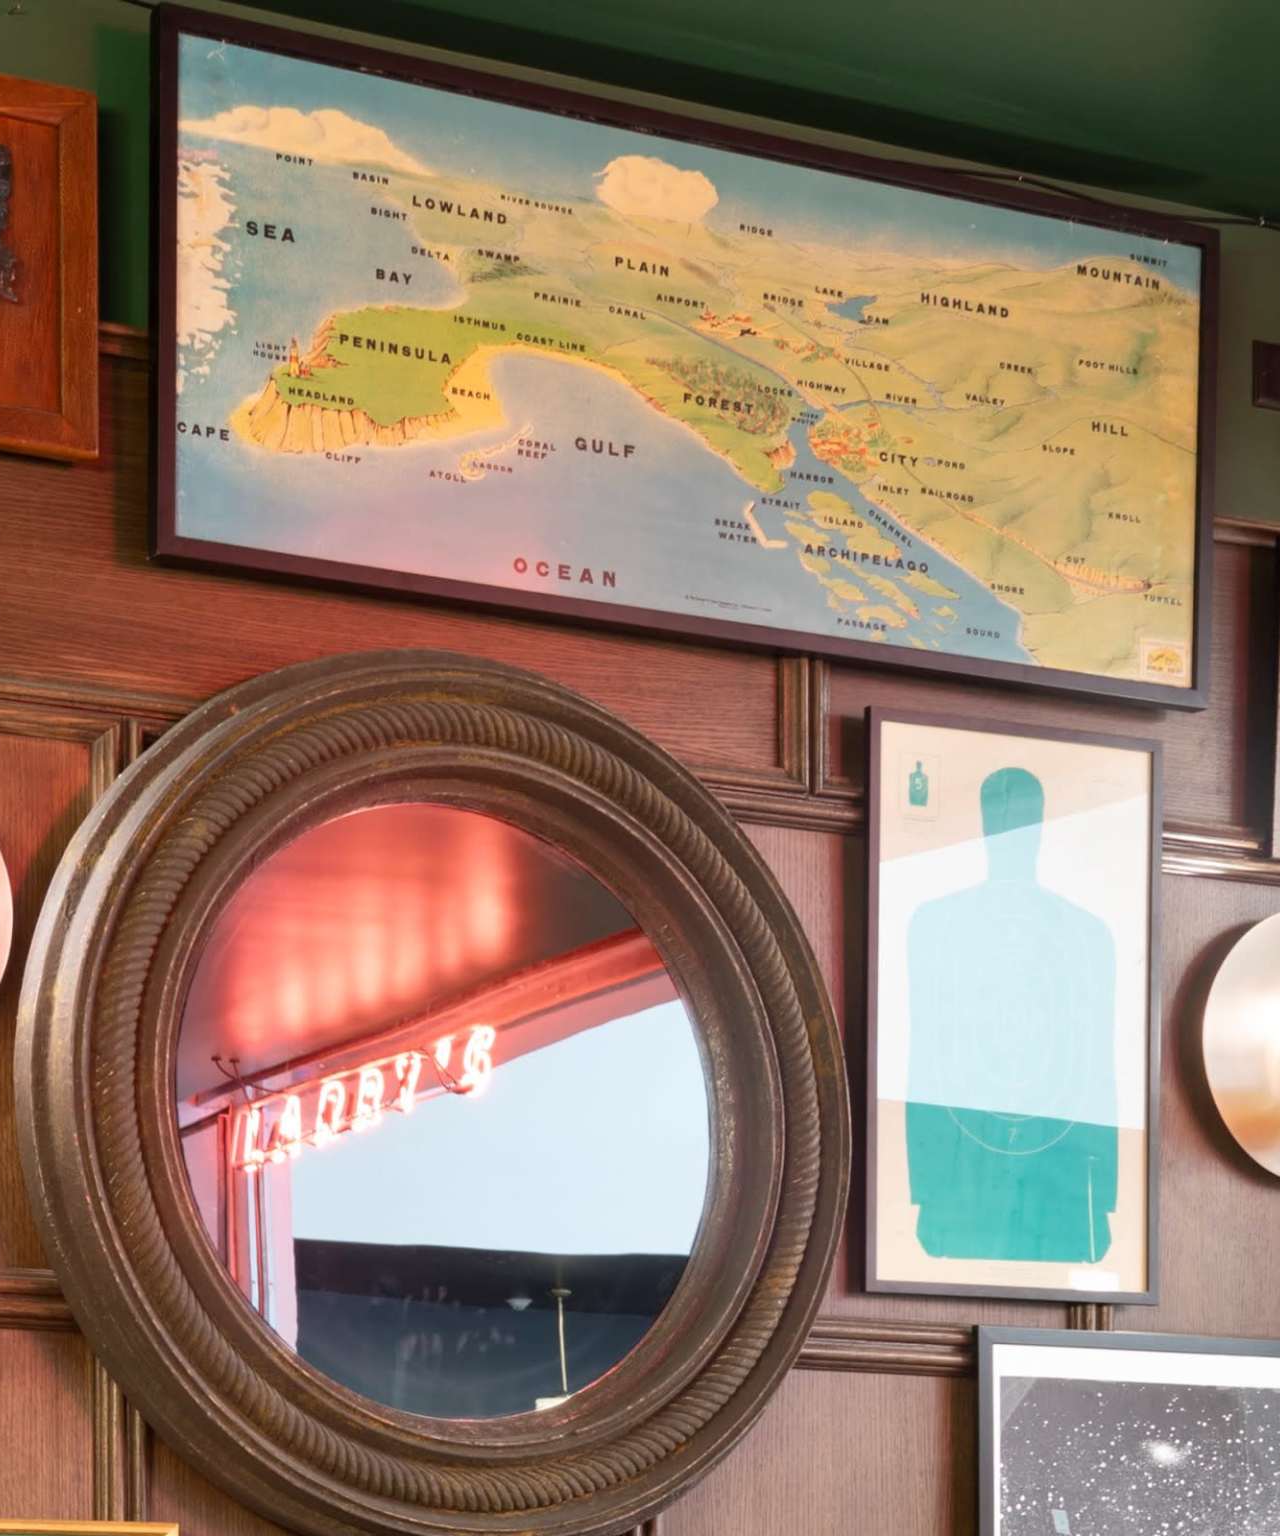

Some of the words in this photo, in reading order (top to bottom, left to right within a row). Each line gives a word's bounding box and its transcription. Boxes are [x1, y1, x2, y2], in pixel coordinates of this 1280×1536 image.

[276, 153, 314, 167] POINT
[352, 171, 389, 185] BASIN
[371, 207, 408, 221] BIGHT
[412, 195, 508, 225] LOWLAND
[246, 221, 295, 243] SEA
[739, 224, 773, 237] RIDGE
[411, 246, 450, 261] DELTA
[478, 249, 520, 263] SWAMP
[1130, 253, 1168, 268] SUMMIT
[615, 256, 670, 277] PLAIN
[375, 269, 412, 285] BAY
[1077, 264, 1161, 290] MOUNTAIN
[534, 291, 581, 308] PRAIRIE
[815, 286, 843, 299] LAKE
[656, 294, 705, 309] AIRPORT
[763, 293, 804, 308] BRIDGE
[921, 293, 1010, 319] HIGHLAND
[609, 306, 646, 320] CANAL
[454, 315, 506, 331] ISTHMUS
[867, 315, 889, 326] DAM
[255, 341, 287, 351] LIGHT
[516, 332, 553, 346] COAST
[559, 341, 586, 352] LINE
[253, 350, 287, 362] HOUSE
[339, 334, 451, 365] PENINSULA
[844, 358, 891, 372] VILLAGE
[999, 362, 1033, 375] CREEK
[1078, 359, 1105, 370] FOOT
[1109, 363, 1138, 376] HILLS
[451, 387, 490, 400] BEACH
[757, 384, 793, 397] LOCKS
[796, 379, 847, 394] HIGHWAY
[288, 387, 355, 405] HEADLAND
[885, 393, 917, 405] RIVER
[965, 392, 1005, 407] VALLEY
[684, 393, 754, 414] FOREST
[177, 422, 230, 441] CAPE
[1091, 421, 1128, 437] HILL
[518, 439, 556, 451] CORAL
[575, 437, 635, 458] GULF
[1042, 444, 1075, 456] SLOPE
[325, 452, 361, 464] CLIFF
[517, 449, 547, 460] REEF
[879, 452, 918, 467] CITY
[429, 471, 467, 483] ATOLL
[790, 471, 834, 485] HARBOR
[878, 485, 909, 496] INLET
[921, 487, 974, 503] RAILROAD
[761, 497, 800, 510] STRAIT
[714, 519, 751, 531] BREAK
[824, 516, 864, 529] ISLAND
[1108, 512, 1141, 524] KNOLL
[868, 509, 913, 548] CHANNEL
[719, 532, 757, 544] WATER
[804, 543, 929, 574] ARCHIPELAGO
[513, 558, 616, 588] OCEAN
[990, 583, 1025, 595] SHORE
[837, 617, 887, 632] PASSAGE
